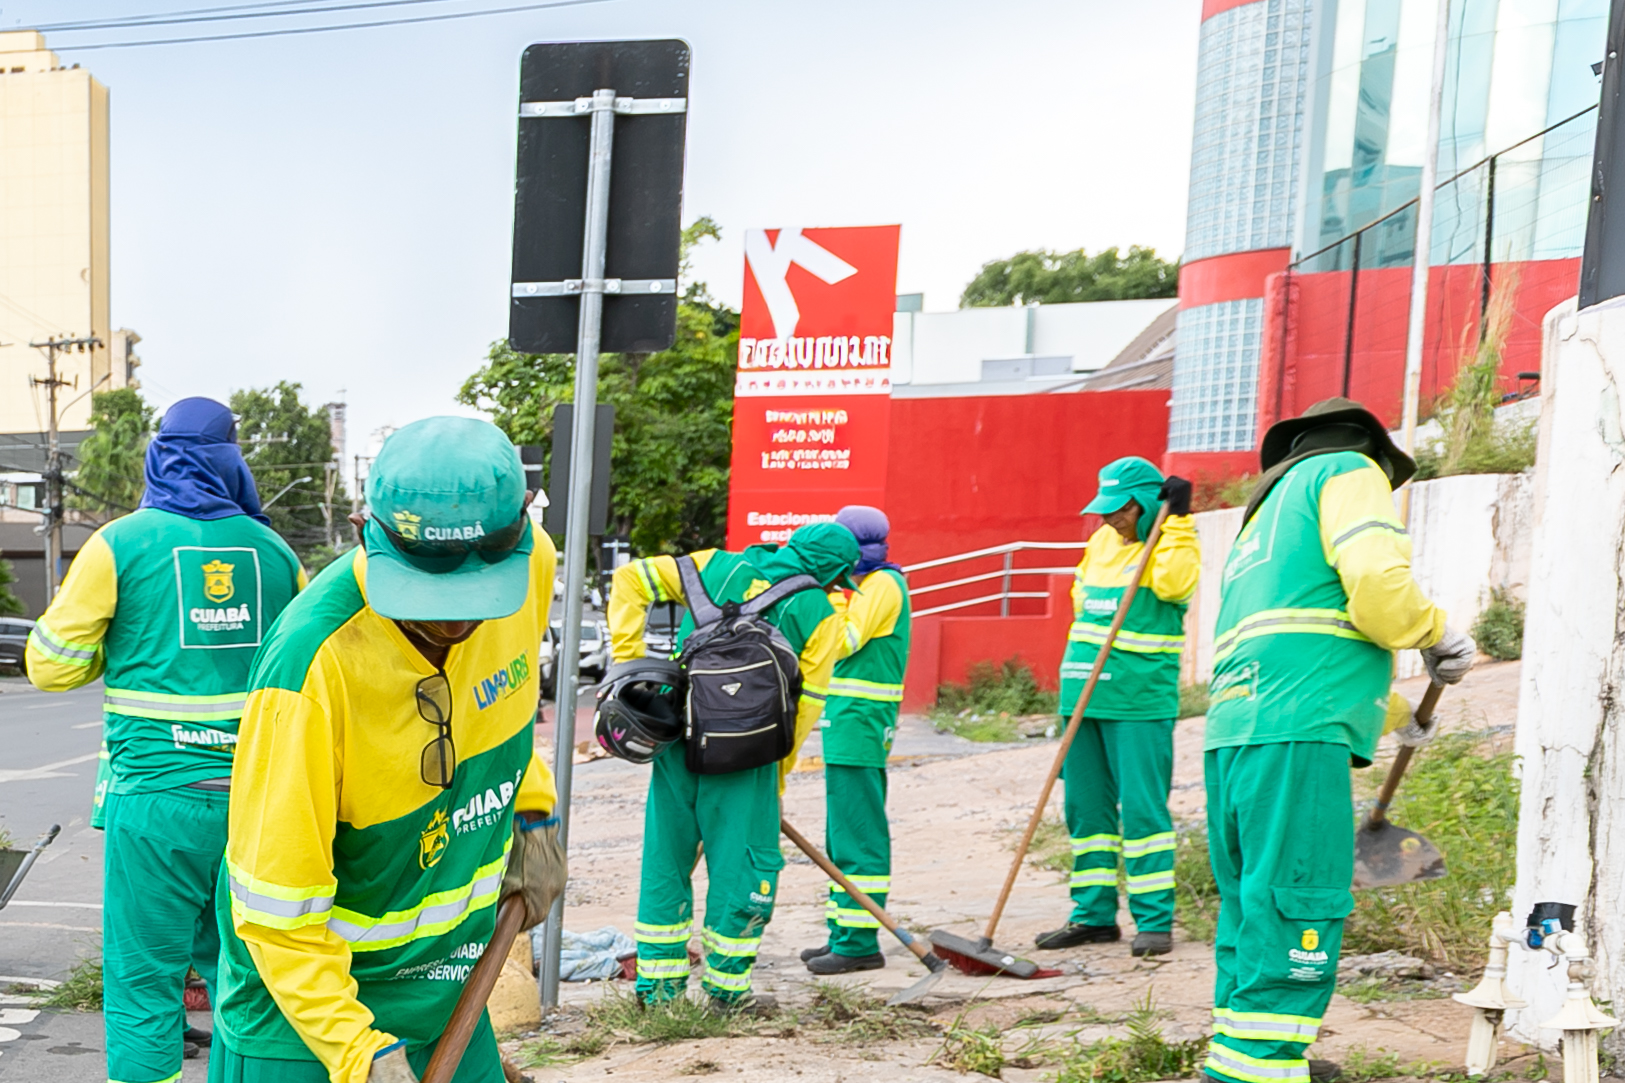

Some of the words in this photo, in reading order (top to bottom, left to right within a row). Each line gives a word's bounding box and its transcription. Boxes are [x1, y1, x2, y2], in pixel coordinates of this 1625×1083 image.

[424, 520, 485, 540] CUIABÁ
[190, 603, 251, 623] CUIABÁ
[197, 622, 244, 631] PREFEITURA
